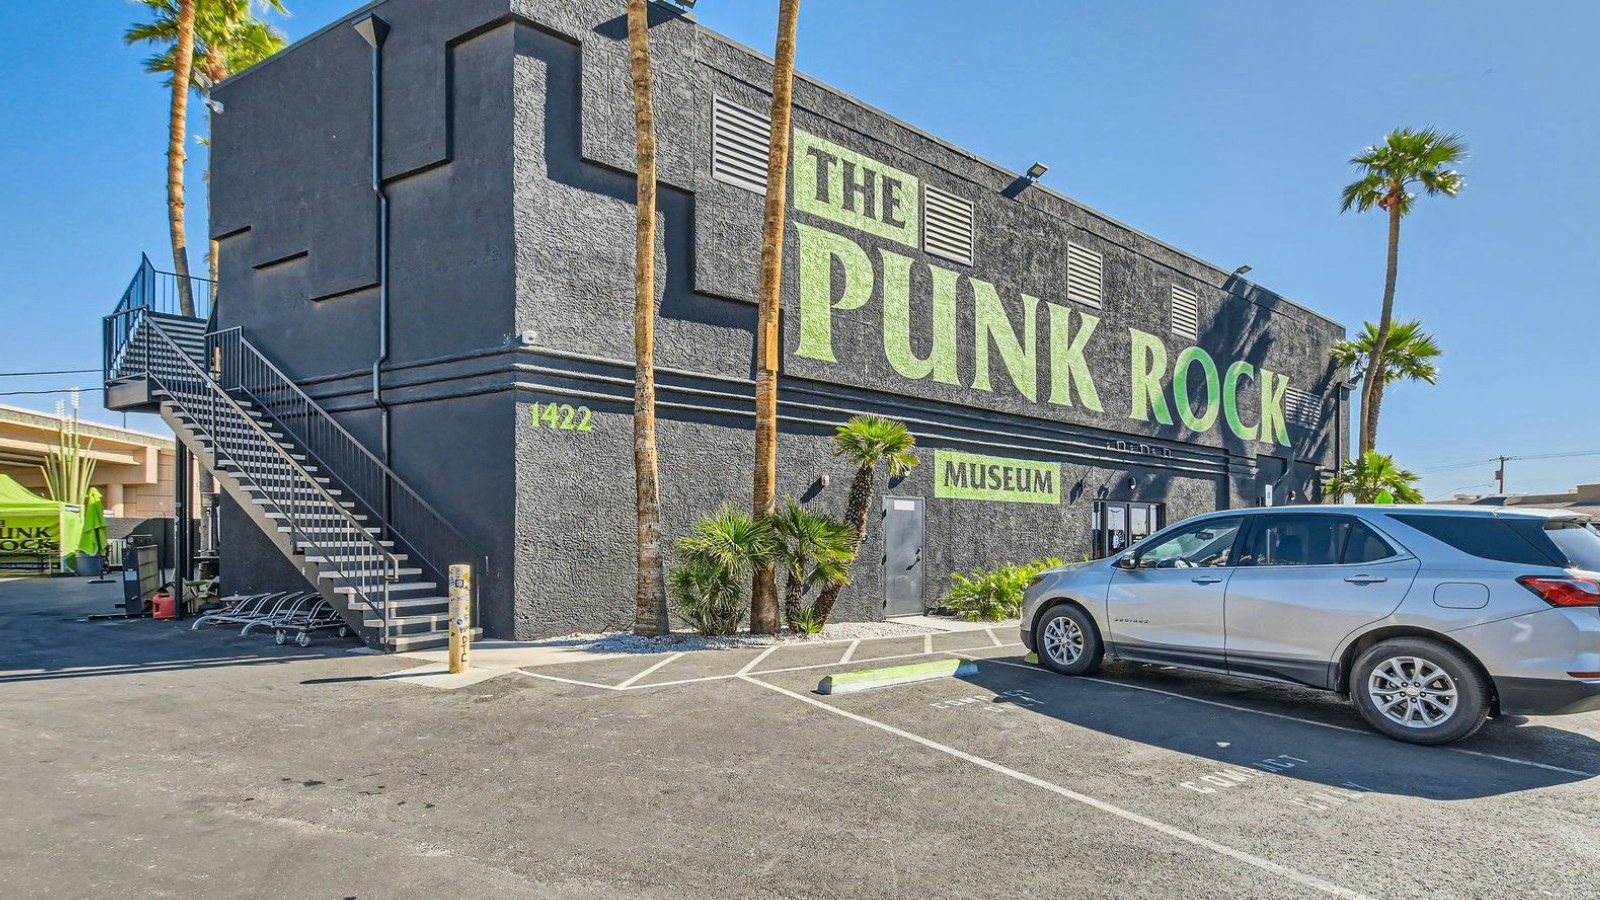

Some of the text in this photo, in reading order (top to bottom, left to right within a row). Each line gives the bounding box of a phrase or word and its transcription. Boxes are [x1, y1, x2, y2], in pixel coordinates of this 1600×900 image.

[806, 146, 906, 229] THE
[795, 221, 1291, 447] PUNK ROCK
[531, 402, 593, 432] 1422
[944, 461, 1053, 493] MUSEUM
[0, 527, 52, 539] UNK
[0, 540, 58, 551] OCK
